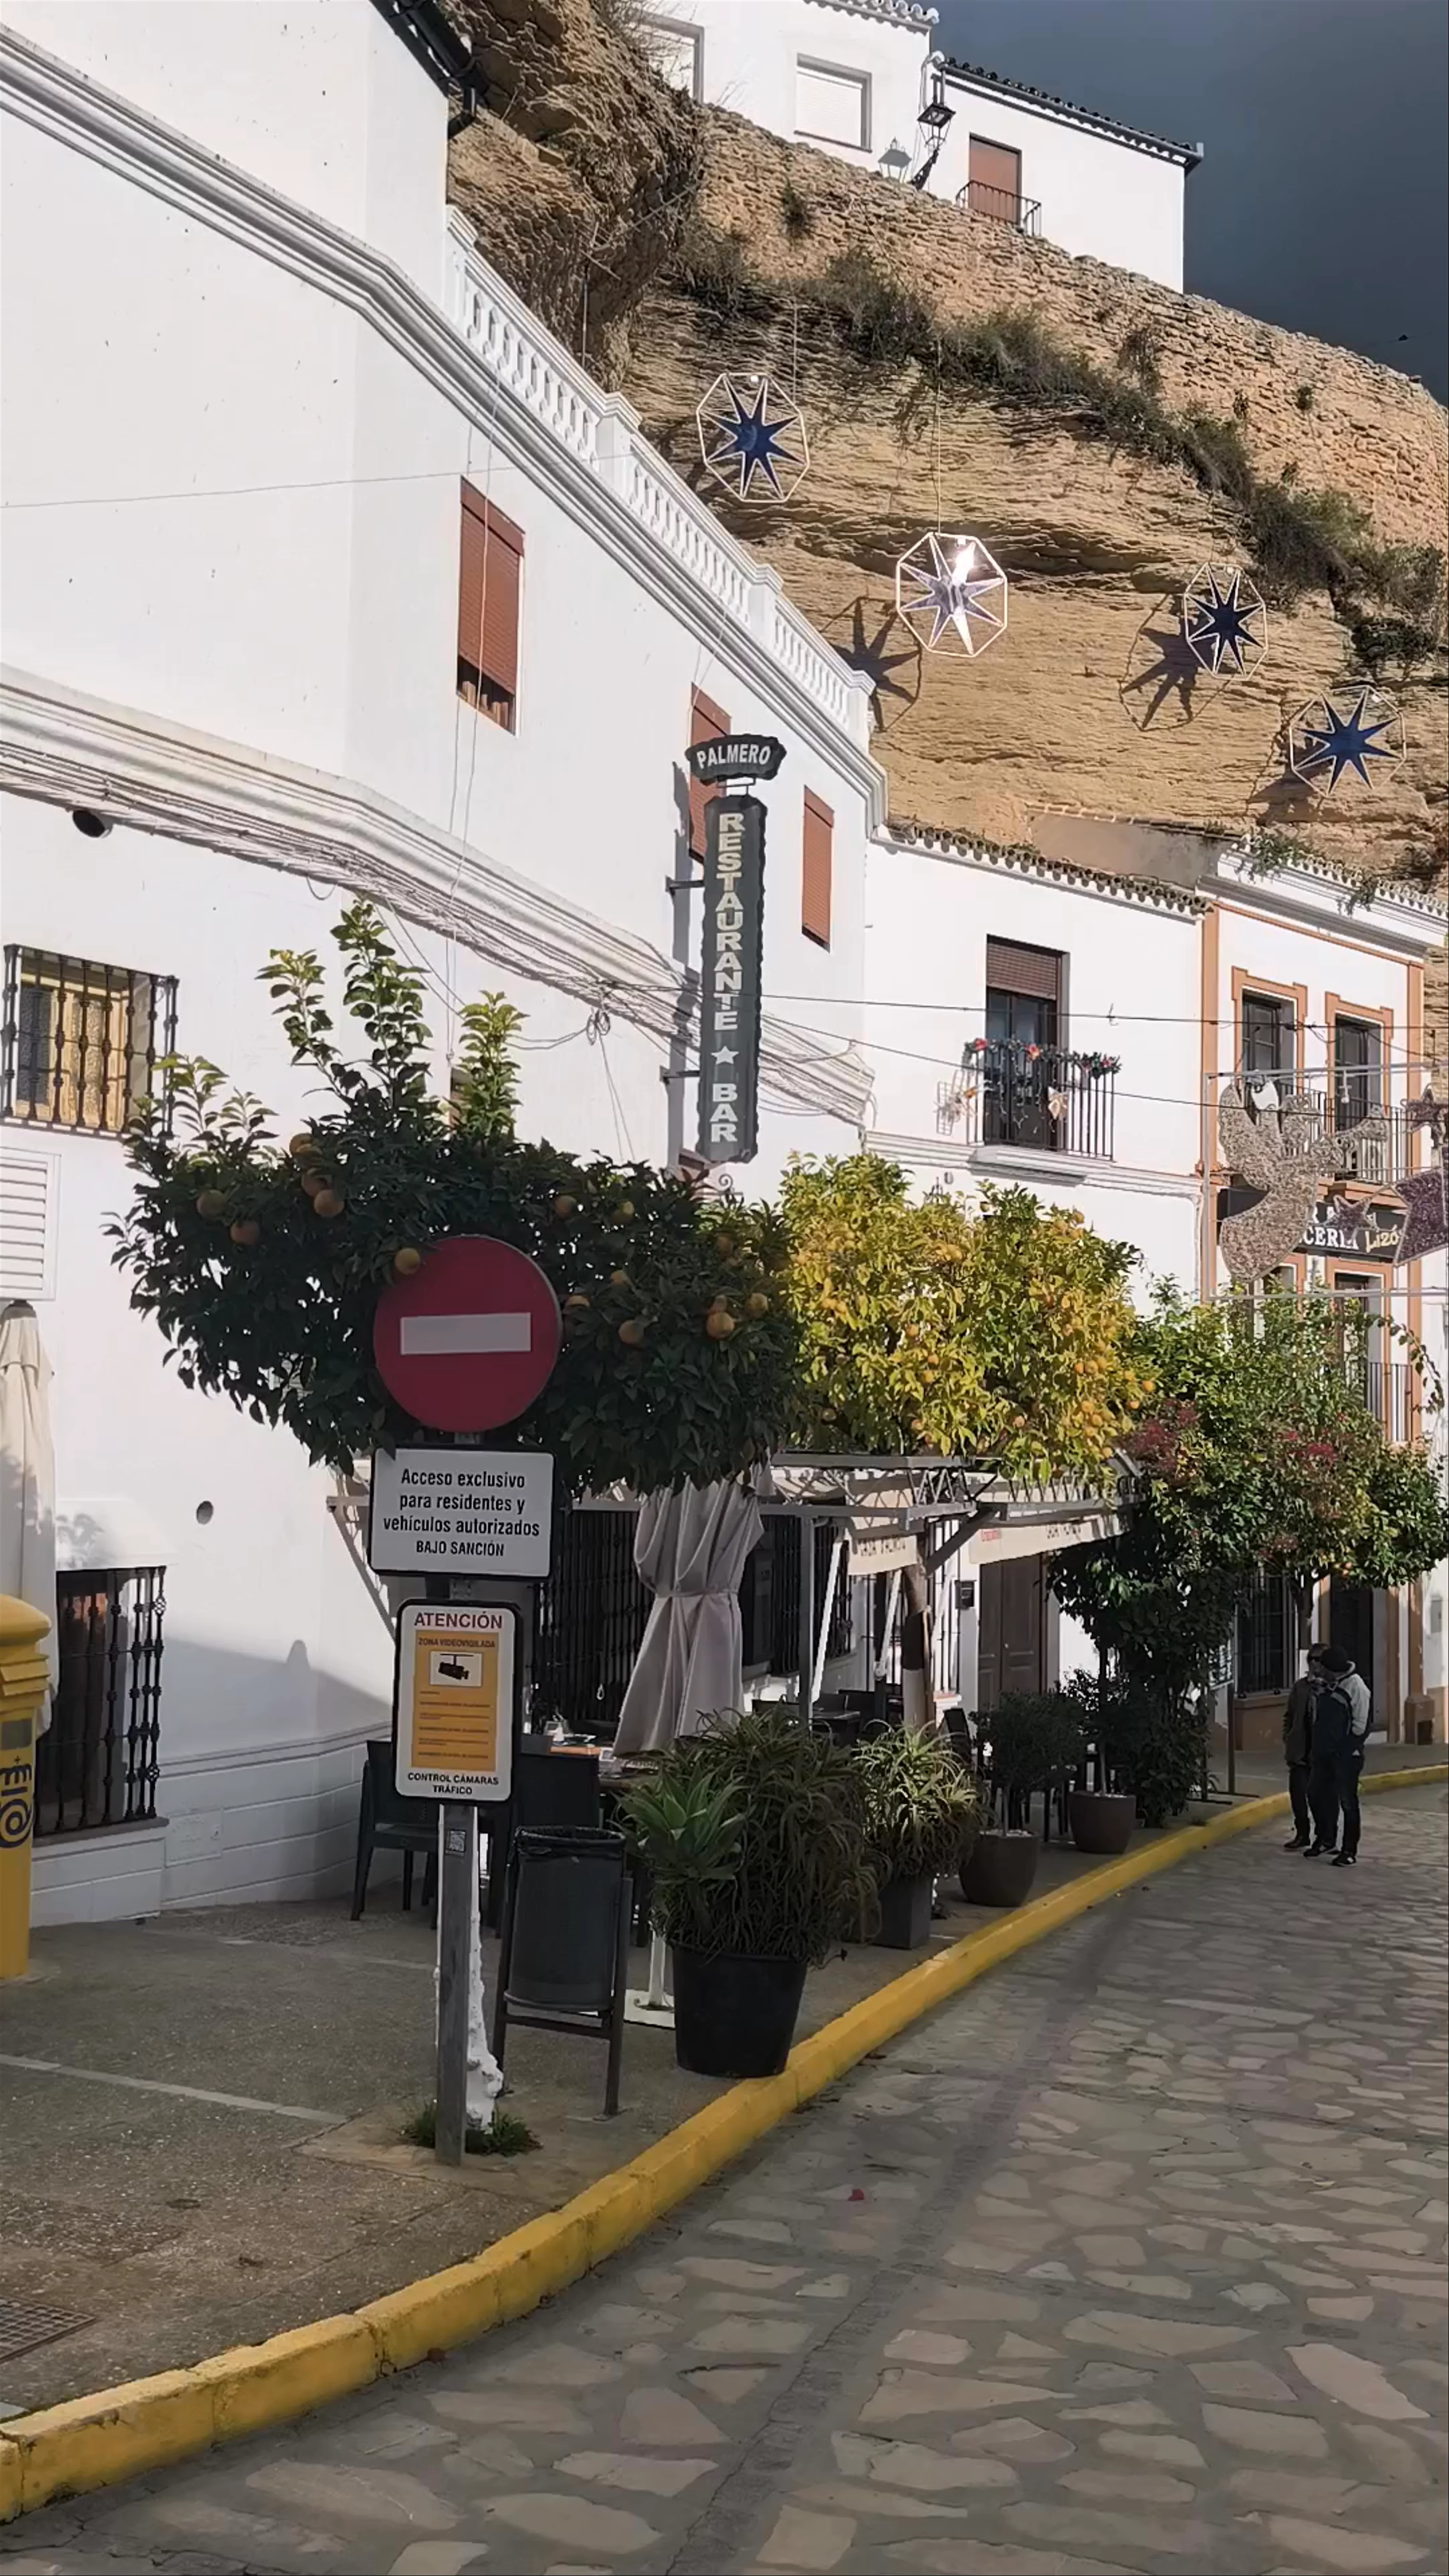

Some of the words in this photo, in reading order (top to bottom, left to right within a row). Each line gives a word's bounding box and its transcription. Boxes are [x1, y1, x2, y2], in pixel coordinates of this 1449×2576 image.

[697, 744, 771, 769] PALMERO
[714, 813, 745, 1031] RESTAURANTE
[710, 1083, 738, 1143] BAR
[401, 1469, 452, 1486] Acceso
[458, 1471, 525, 1488] exclusivo
[400, 1495, 431, 1510] para
[437, 1494, 511, 1511] residentes
[517, 1499, 525, 1515] y
[383, 1515, 451, 1533] vehículos
[456, 1518, 540, 1536] autorizados
[416, 1541, 447, 1554] BAJO
[450, 1540, 505, 1556] SANCIÓN
[414, 1611, 503, 1629] ATENCIÓN
[418, 1637, 438, 1646] ZONA
[408, 1772, 451, 1783] CONTROL
[454, 1772, 499, 1785] CÁMARAS
[432, 1783, 472, 1795] TRÁFICO
